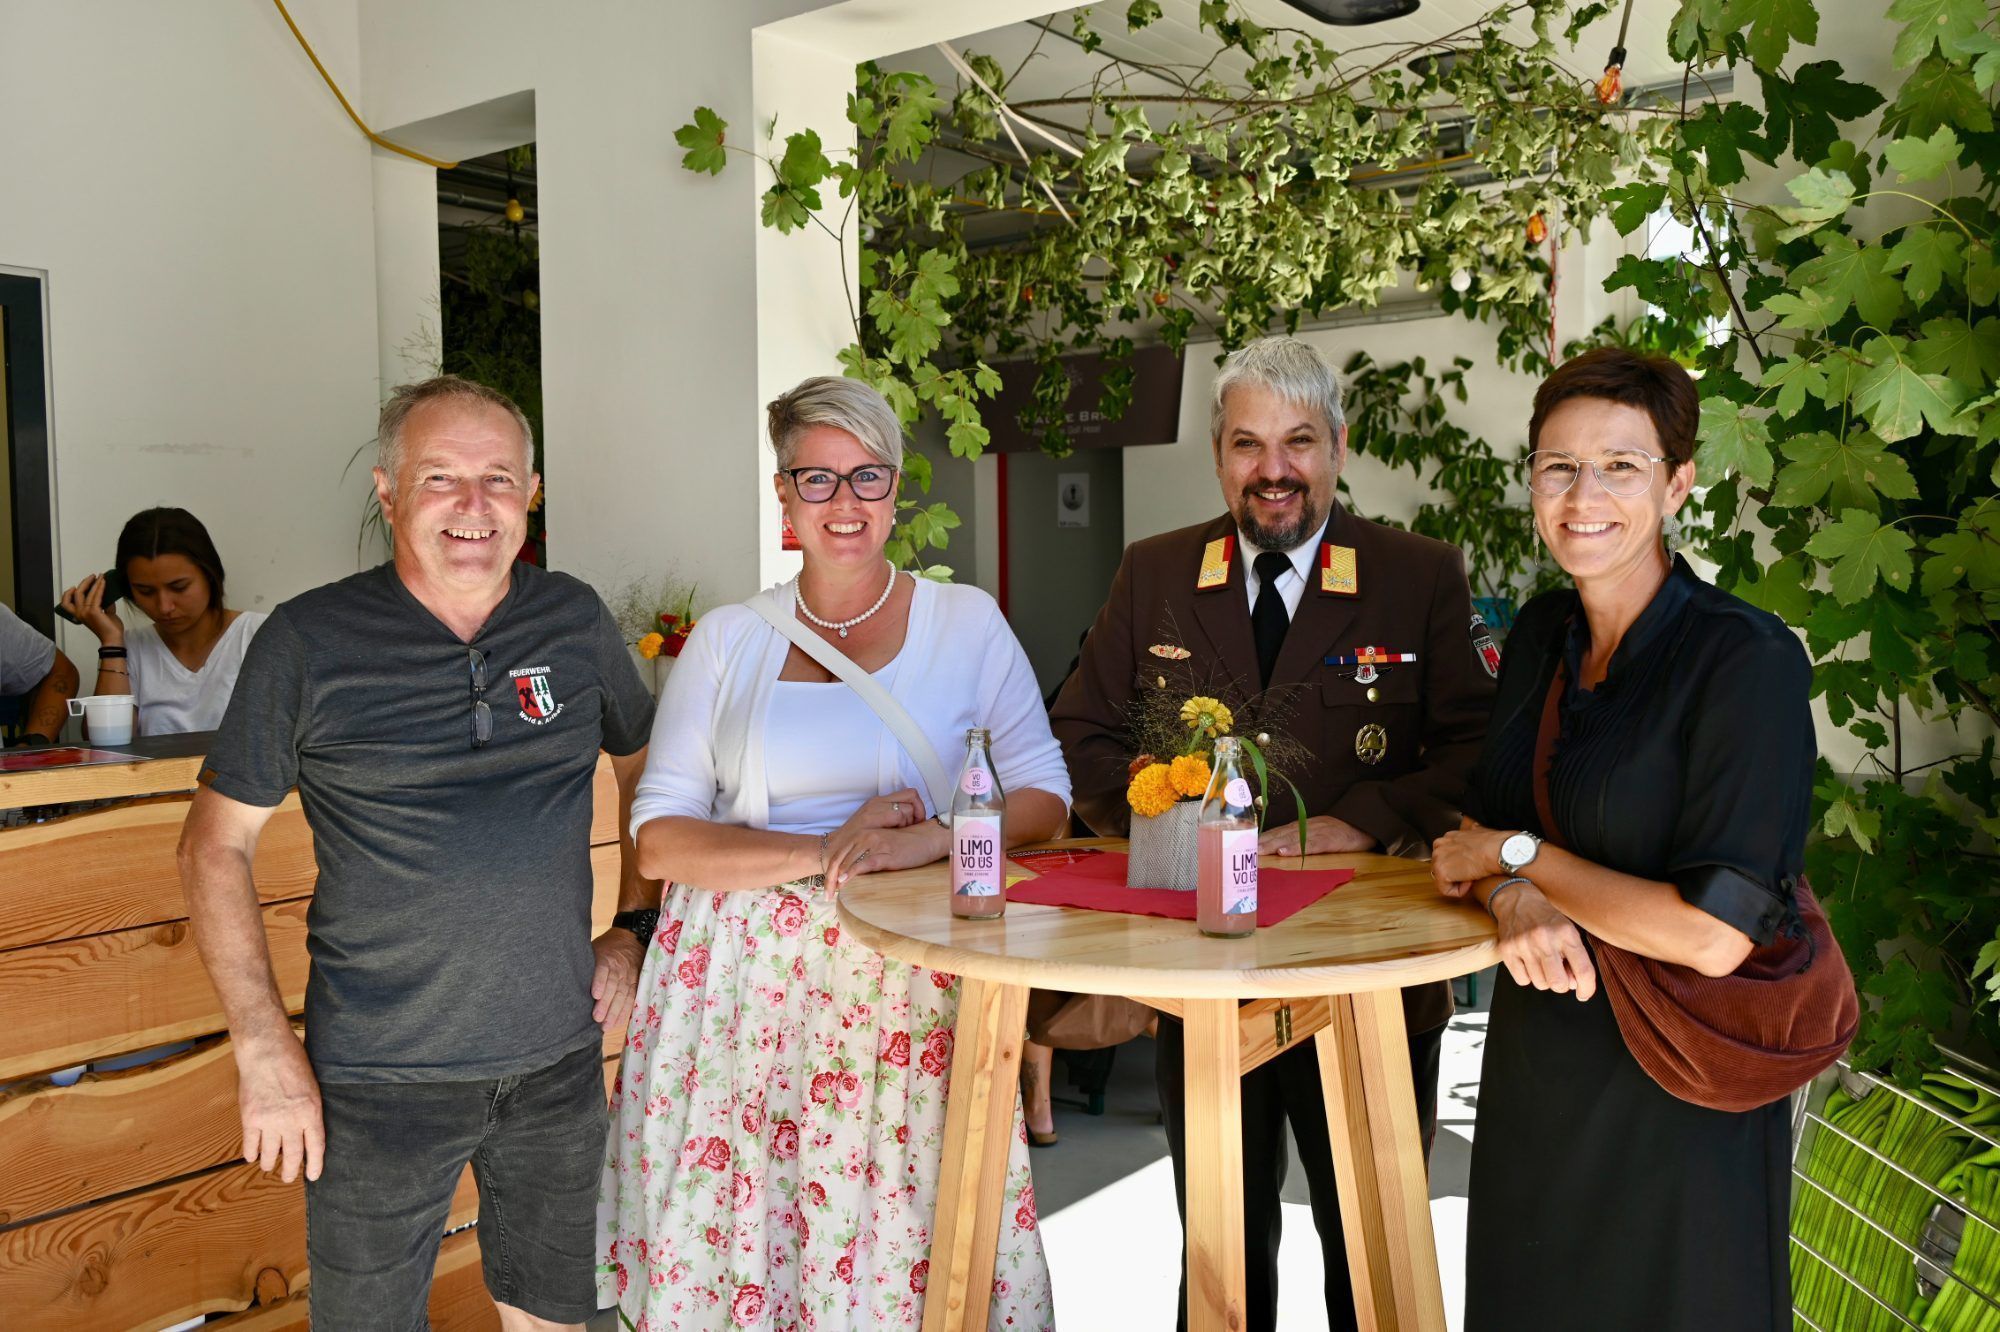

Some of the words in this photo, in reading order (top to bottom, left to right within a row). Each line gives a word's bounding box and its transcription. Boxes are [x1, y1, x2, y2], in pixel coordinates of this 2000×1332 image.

[509, 666, 551, 678] FEUERWEHR
[519, 710, 537, 724] Wald
[960, 839, 993, 855] LIMO
[960, 856, 975, 869] VO
[1233, 871, 1248, 885] VO
